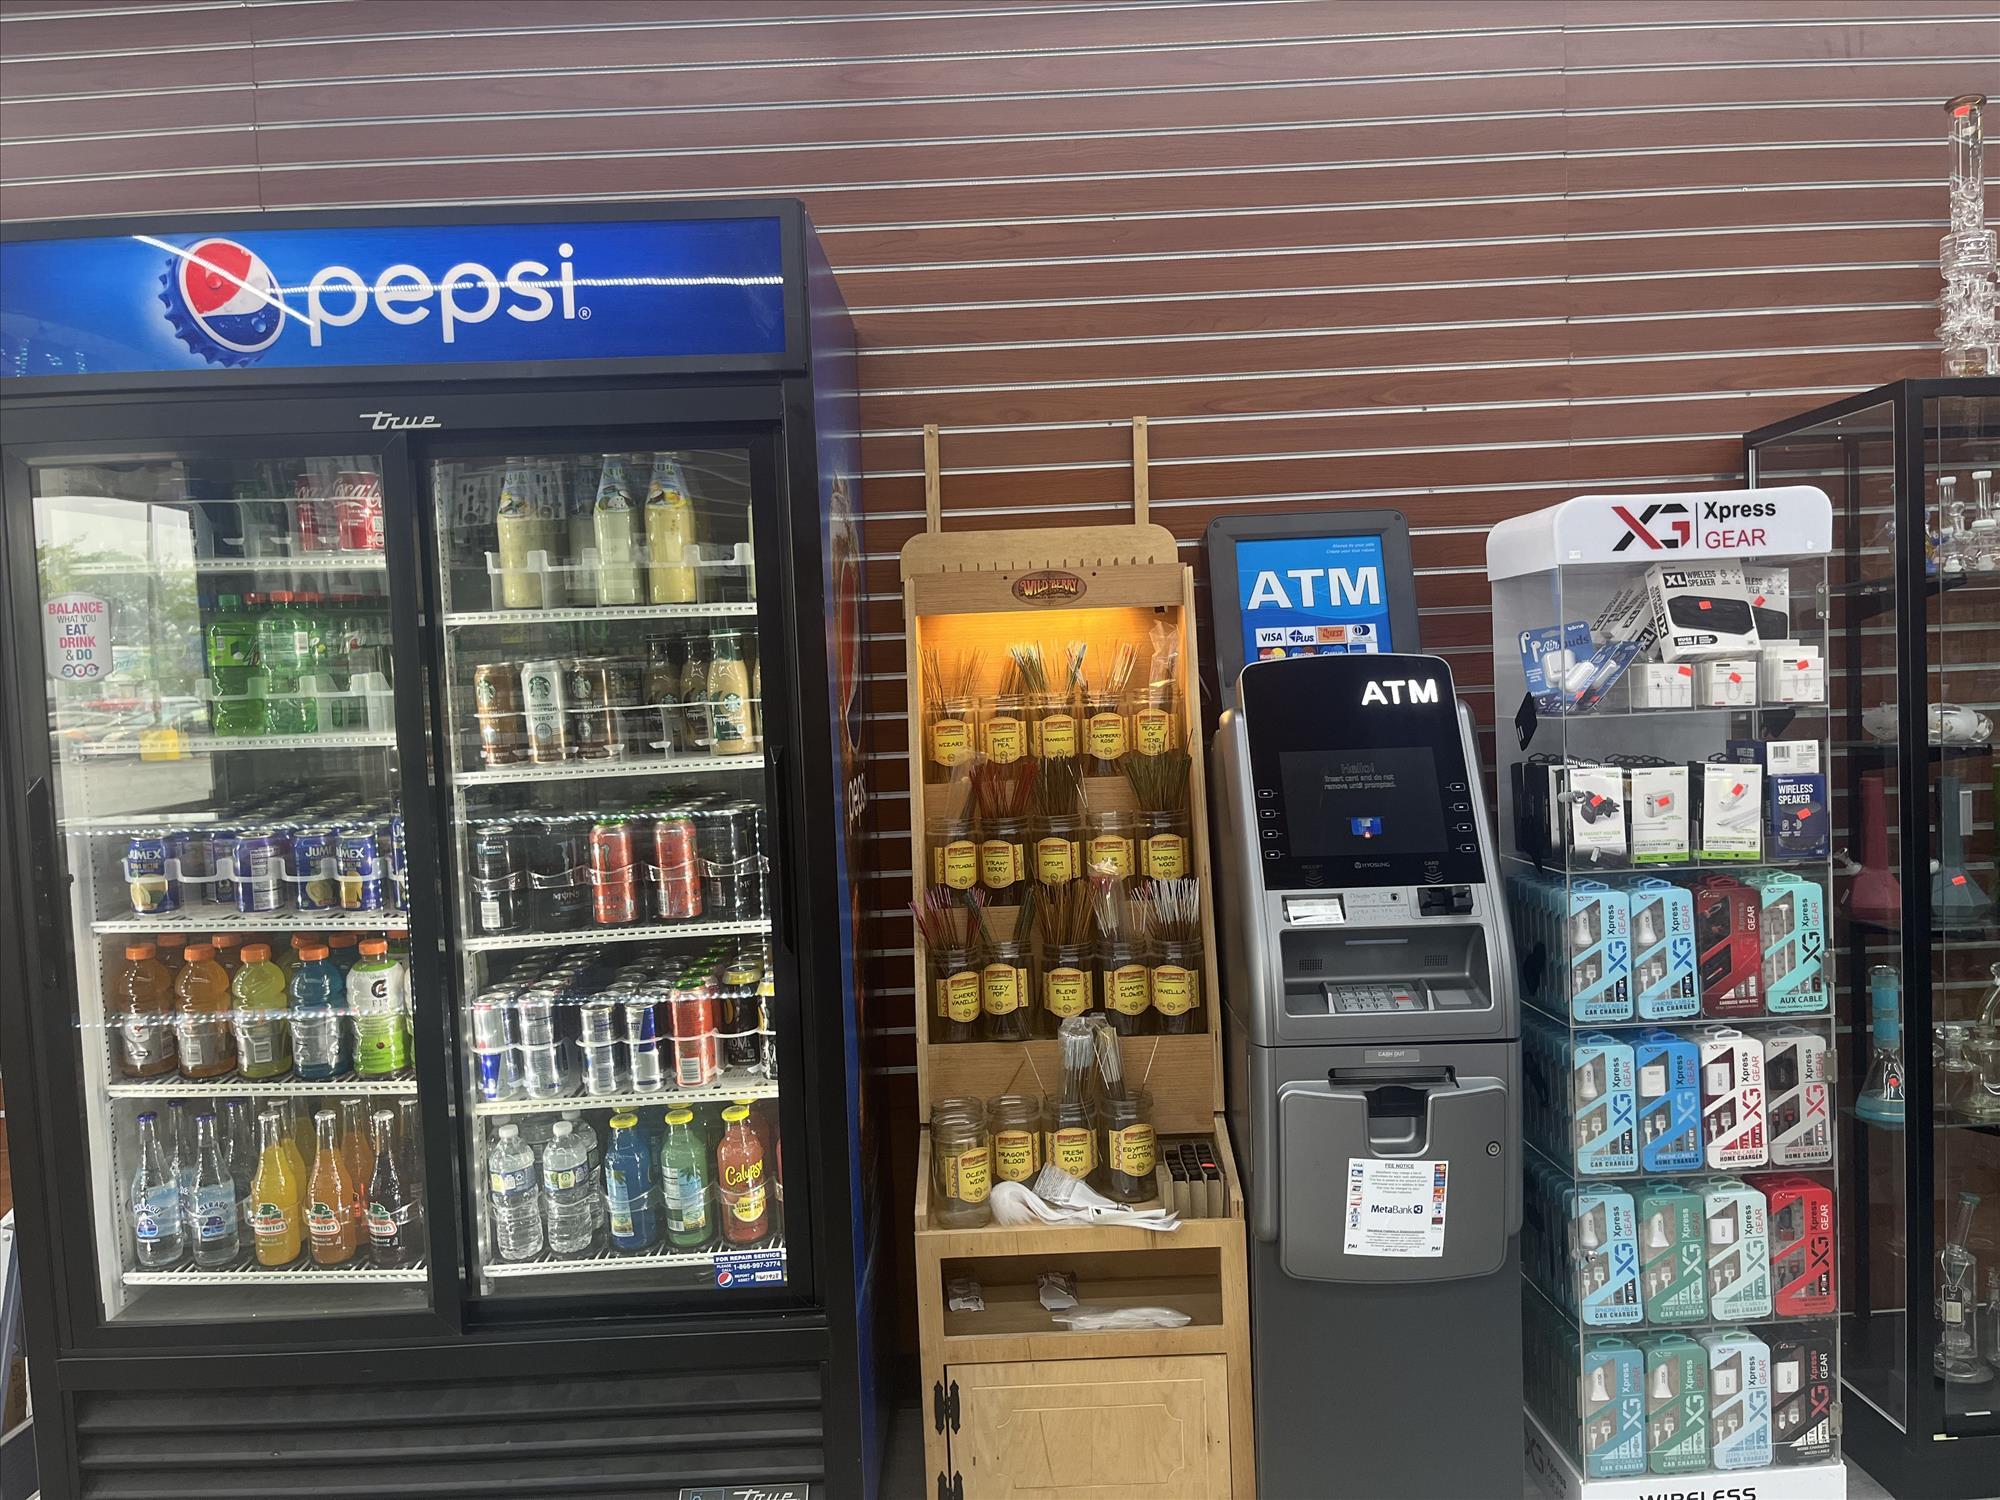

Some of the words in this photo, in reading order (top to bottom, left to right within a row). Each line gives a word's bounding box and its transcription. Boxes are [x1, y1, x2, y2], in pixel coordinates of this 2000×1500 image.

[309, 242, 578, 347] pepsi
[1704, 501, 1776, 523] Xpress
[1611, 503, 1690, 551] XG
[1705, 528, 1766, 549] GEAR
[1020, 580, 1048, 596] WILD
[1051, 578, 1078, 593] BERRY
[1247, 566, 1380, 610] ATM
[1664, 573, 1687, 587] XL
[1687, 570, 1716, 578] WIRELESS
[1688, 578, 1716, 587] SPEAKER
[48, 602, 104, 615] BALANCE
[57, 615, 79, 624] WHAT
[81, 614, 96, 623] YOU
[59, 636, 97, 649] DRINK
[66, 624, 88, 636] EAT
[1261, 632, 1282, 642] VISA
[1296, 634, 1314, 642] PLUS
[66, 650, 74, 661] &
[76, 648, 92, 660] DO
[1361, 679, 1439, 706] ATM
[1778, 784, 1814, 794] WIRELESS
[1778, 794, 1811, 804] SPEAKER
[128, 849, 161, 860] JUMEX
[1607, 904, 1616, 935] Xpress
[1618, 908, 1626, 934] GEAR
[1672, 901, 1680, 932] Xpress
[1682, 905, 1690, 930] GEAR
[1747, 905, 1755, 931] GEAR
[1801, 898, 1810, 927] Xpress
[1811, 902, 1819, 926] GEAR
[1607, 941, 1627, 974] XG
[1672, 938, 1693, 971] XG
[1802, 931, 1821, 965] XG
[952, 998, 978, 1006] VANILLA
[953, 991, 976, 999] CHERRY
[1780, 996, 1796, 1004] AUX
[1798, 995, 1823, 1003] CABLE
[1612, 1057, 1621, 1088] Xpress
[1623, 1061, 1631, 1087] GEAR
[1676, 1055, 1685, 1085] Xpress
[1687, 1058, 1696, 1084] GEAR
[1741, 1052, 1750, 1082] Xpress
[1752, 1055, 1760, 1081] GEAR
[1805, 1049, 1814, 1079] Xpress
[1815, 1052, 1824, 1078] GEAR
[1613, 1093, 1632, 1126] XG
[1677, 1091, 1696, 1125] XG
[1742, 1087, 1761, 1120] XG
[1805, 1084, 1825, 1118] XG
[1122, 1144, 1153, 1152] EGYPTIAN
[1127, 1152, 1153, 1160] COTTON
[966, 1168, 987, 1179] OCEAN
[970, 1177, 985, 1185] WIND
[1371, 1204, 1413, 1215] MetaBank
[1613, 1206, 1622, 1237] Xpress
[1623, 1209, 1633, 1236] GEAR
[1745, 1205, 1754, 1235] Xpress
[1755, 1208, 1763, 1234] GEAR
[1811, 1201, 1819, 1231] Xpress
[1820, 1204, 1829, 1230] GEAR
[1682, 1208, 1690, 1238] Xpress
[1615, 1243, 1635, 1276] XG
[1682, 1243, 1702, 1277] XG
[1746, 1240, 1765, 1272] XG
[1811, 1236, 1829, 1268] XG
[1622, 1362, 1630, 1392] Xpress
[1685, 1360, 1694, 1390] Xpress
[1748, 1356, 1757, 1385] Xpress
[1759, 1359, 1767, 1384] GEAR
[1810, 1350, 1818, 1380] Xpress
[1820, 1353, 1828, 1379] GEAR
[1686, 1394, 1704, 1427] XG
[1749, 1390, 1767, 1422] XG
[1810, 1384, 1829, 1418] XG
[1622, 1398, 1642, 1431] XG
